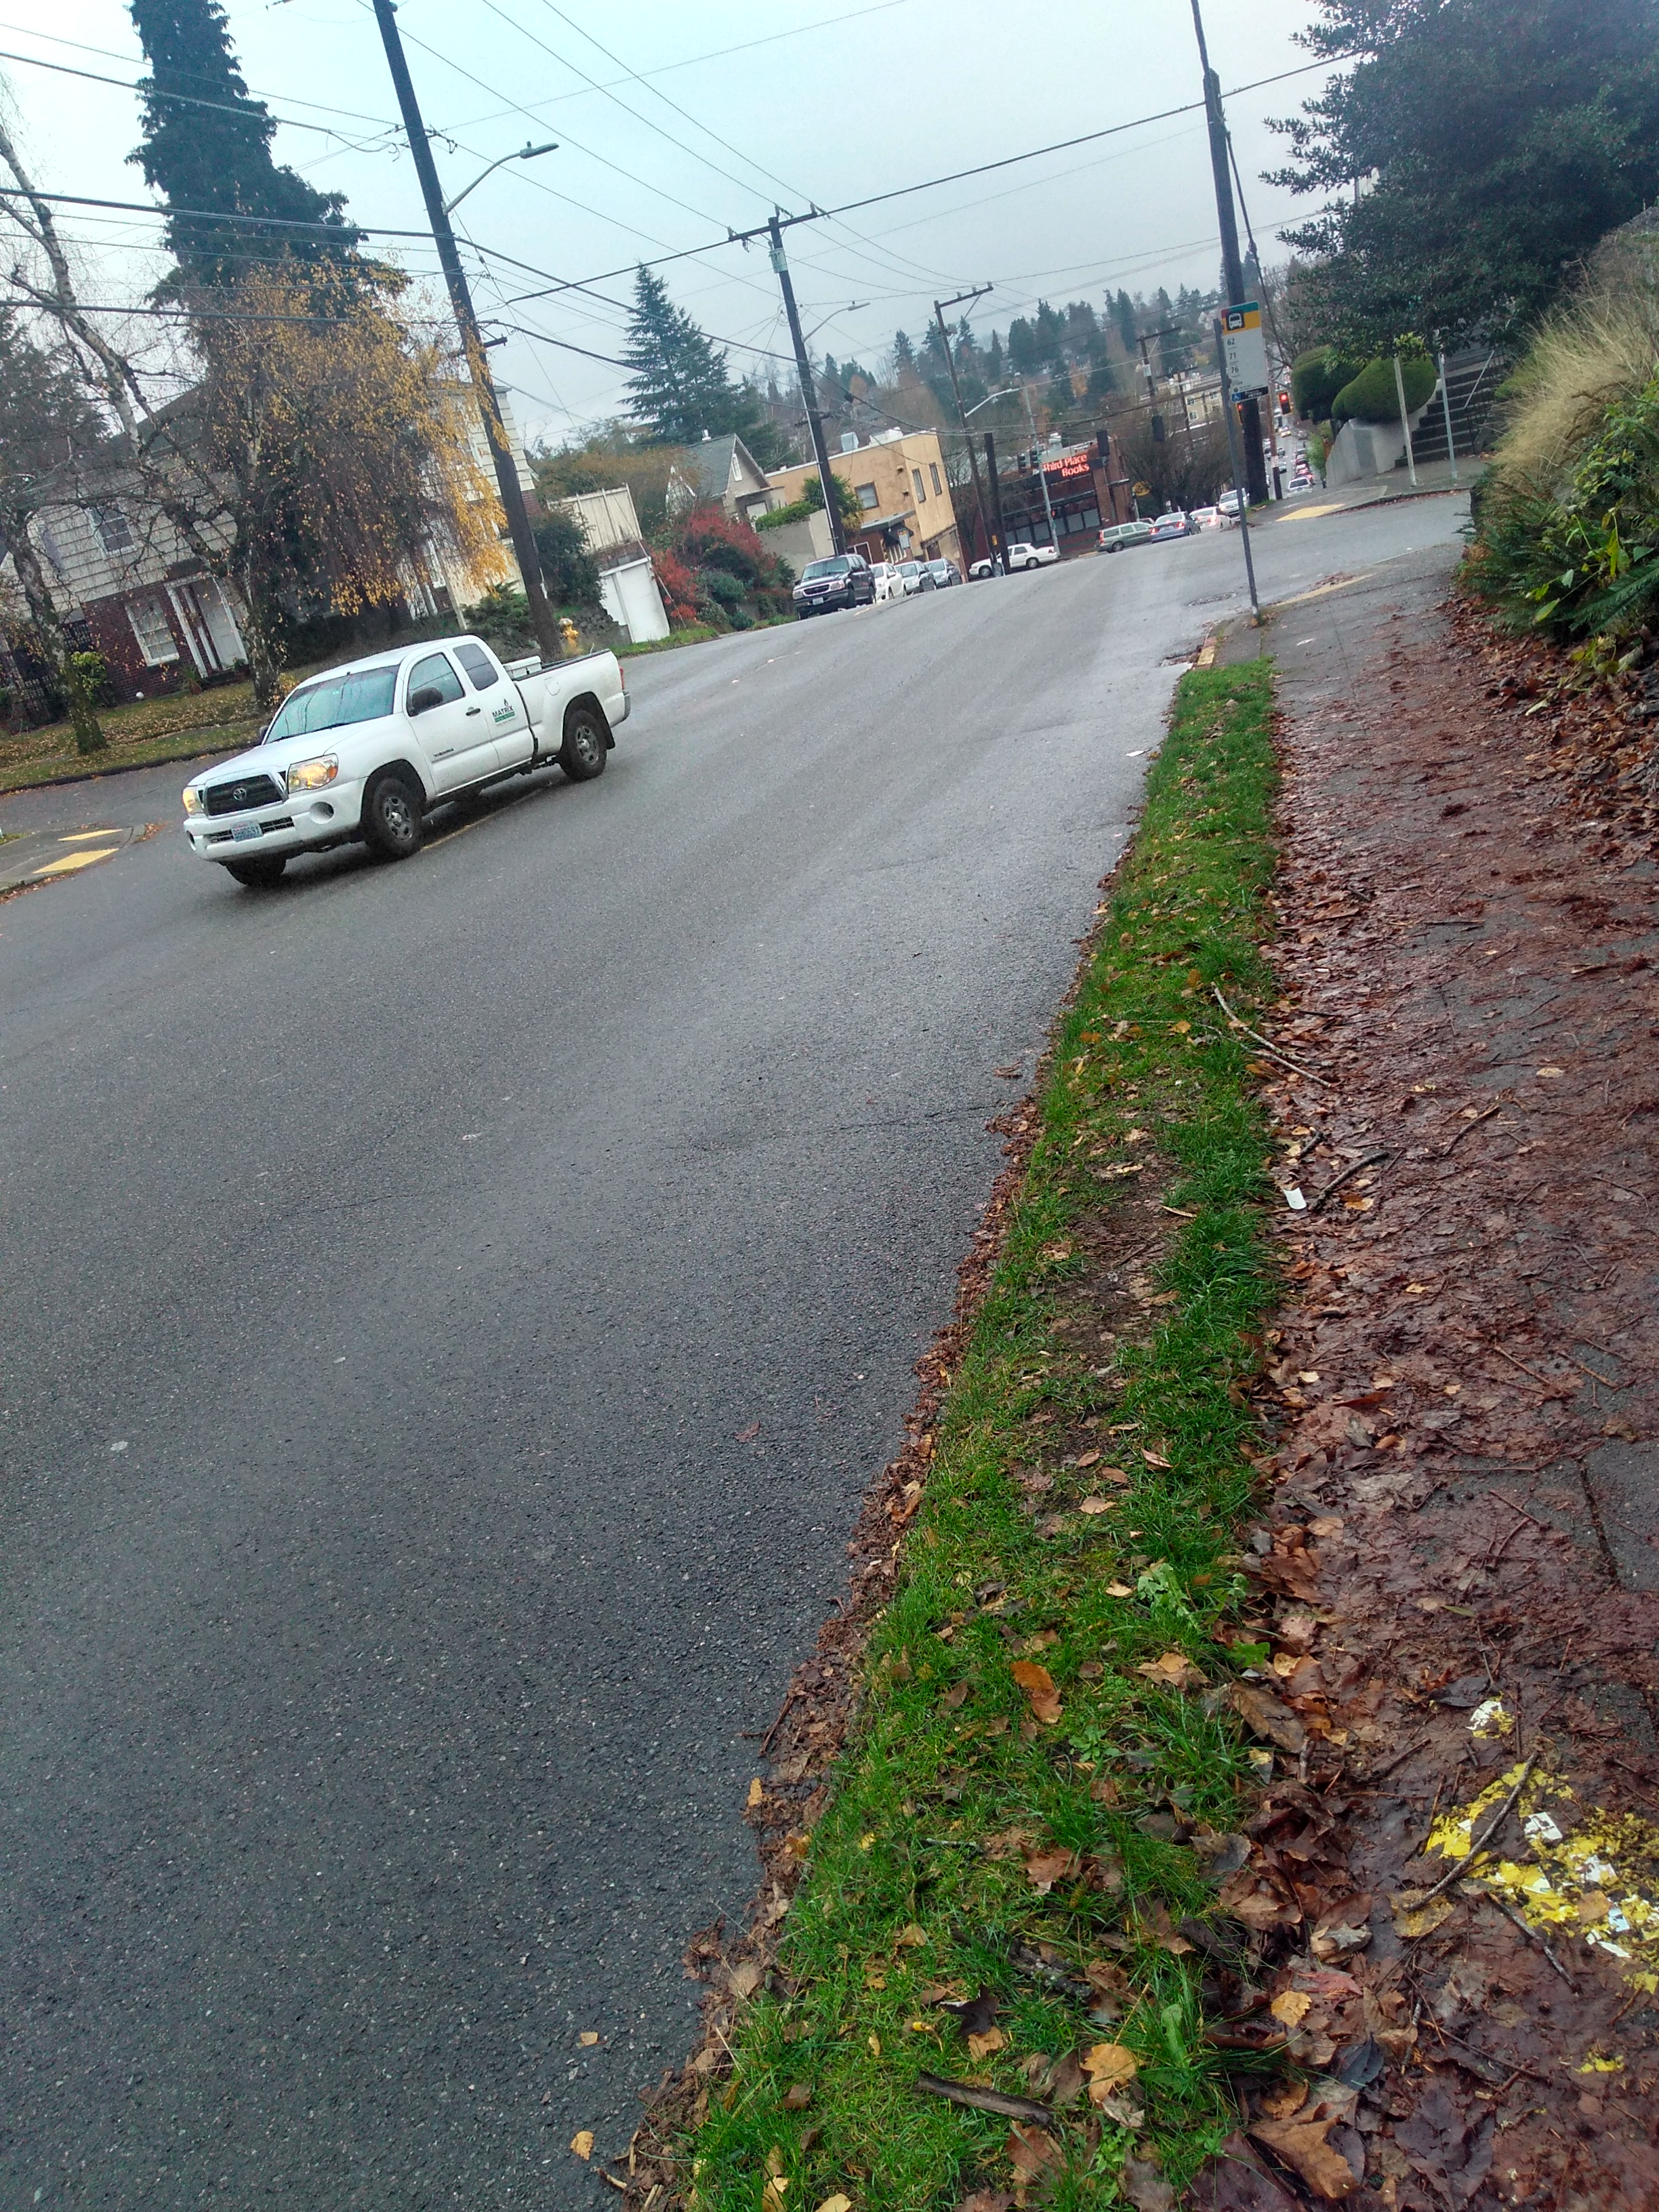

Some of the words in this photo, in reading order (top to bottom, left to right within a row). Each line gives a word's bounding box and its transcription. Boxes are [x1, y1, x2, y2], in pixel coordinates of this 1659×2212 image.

[1065, 454, 1087, 467] Place
[1062, 464, 1090, 477] Books
[492, 705, 514, 717] MATRIX
